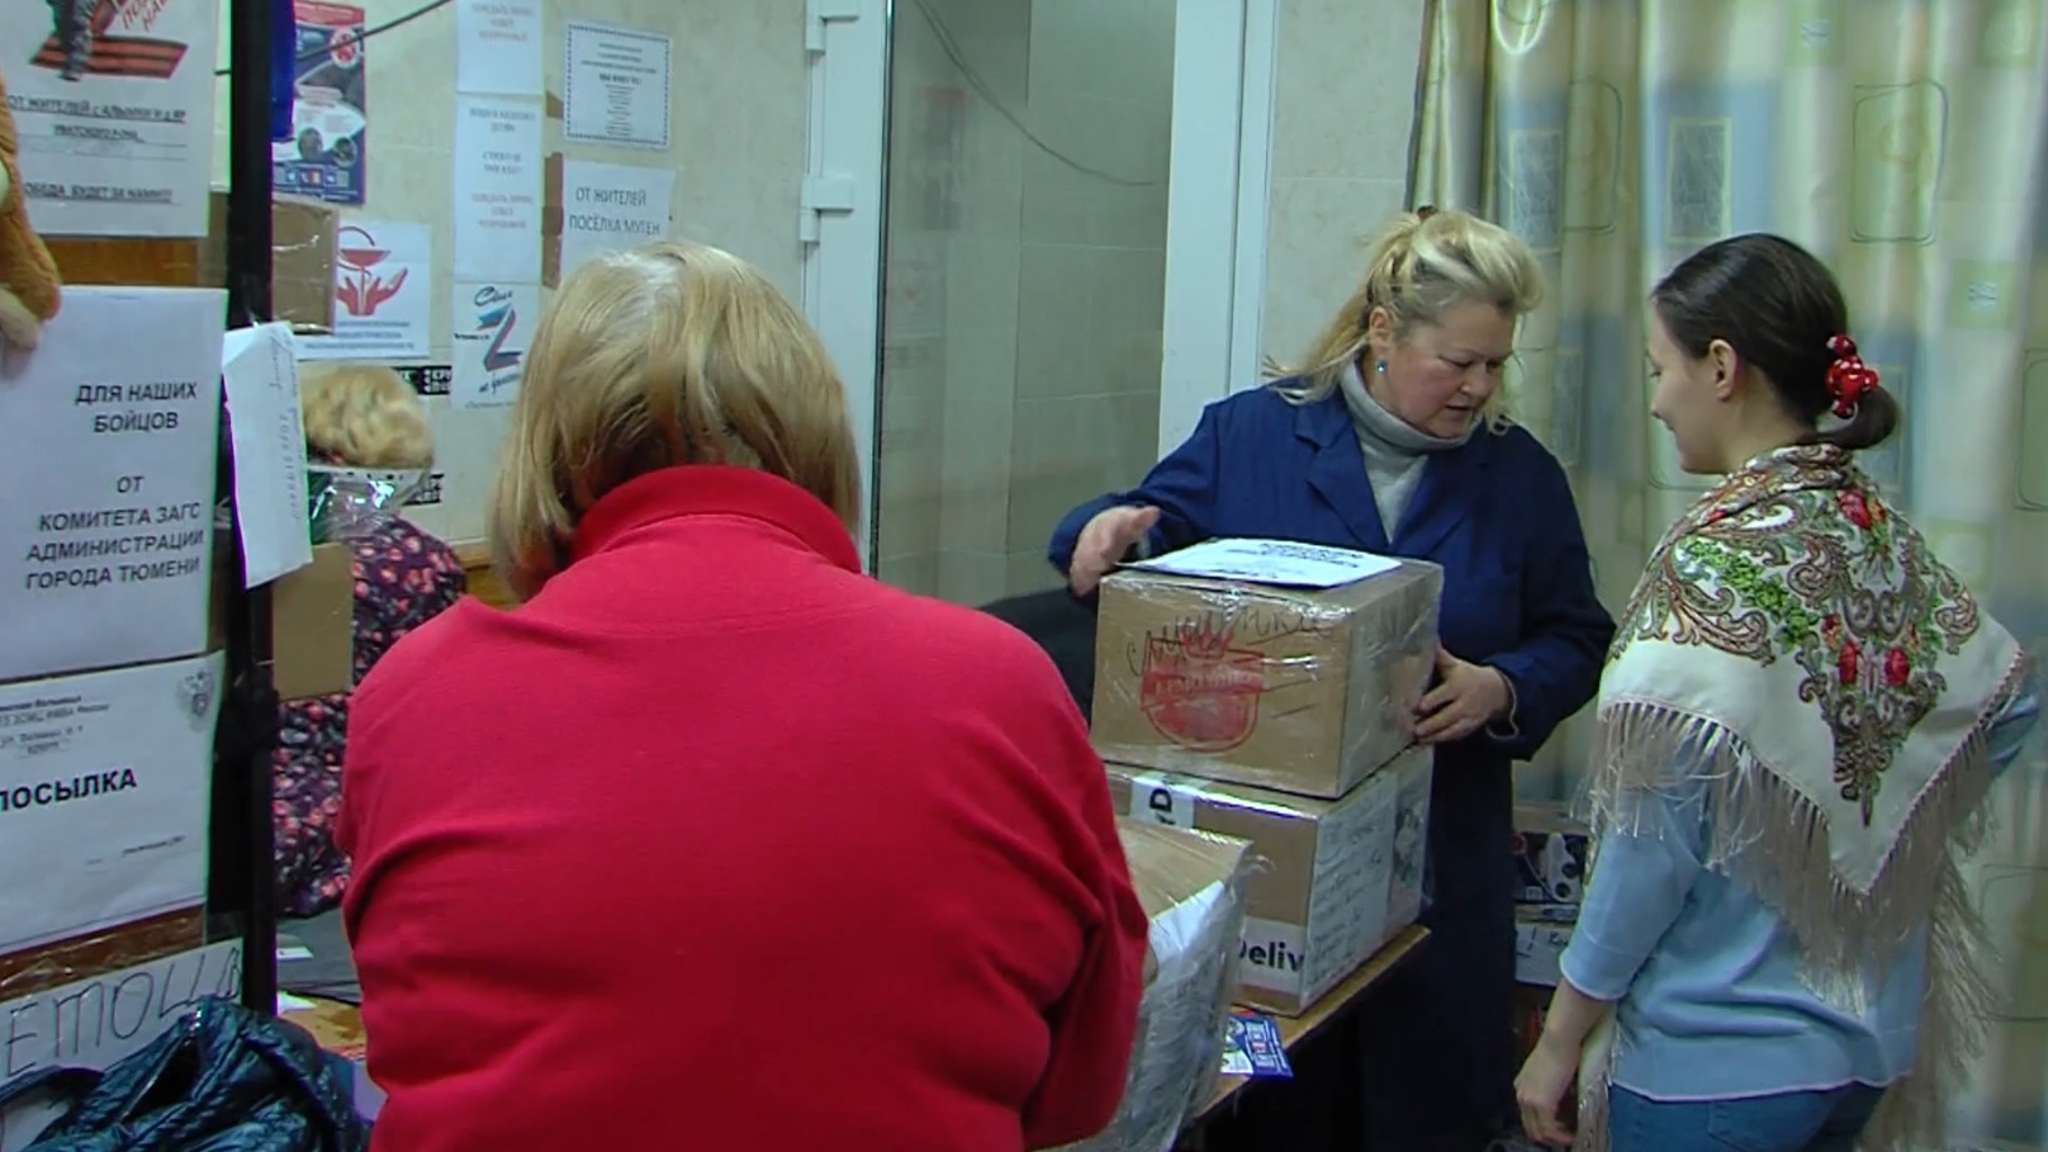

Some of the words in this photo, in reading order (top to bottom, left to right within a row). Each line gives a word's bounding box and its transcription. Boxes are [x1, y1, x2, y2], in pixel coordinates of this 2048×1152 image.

[24, 182, 66, 199] ОБЕДА
[576, 186, 590, 201] ОТ
[594, 187, 646, 206] ЖИТЕЛЕЙ
[75, 384, 122, 405] ДЛЯ
[129, 382, 197, 401] НАШИХ
[94, 410, 179, 432] БОЙЦОВ
[117, 476, 144, 493] ОТ
[39, 506, 152, 532] КОМИТЕТА
[156, 502, 200, 524] ЗАГС
[26, 530, 204, 563] АДМИНИСТРАЦИИ
[26, 566, 112, 590] ГОРОДА
[119, 559, 200, 583] ТЮМЕНИ
[1239, 939, 1305, 971] eliv
